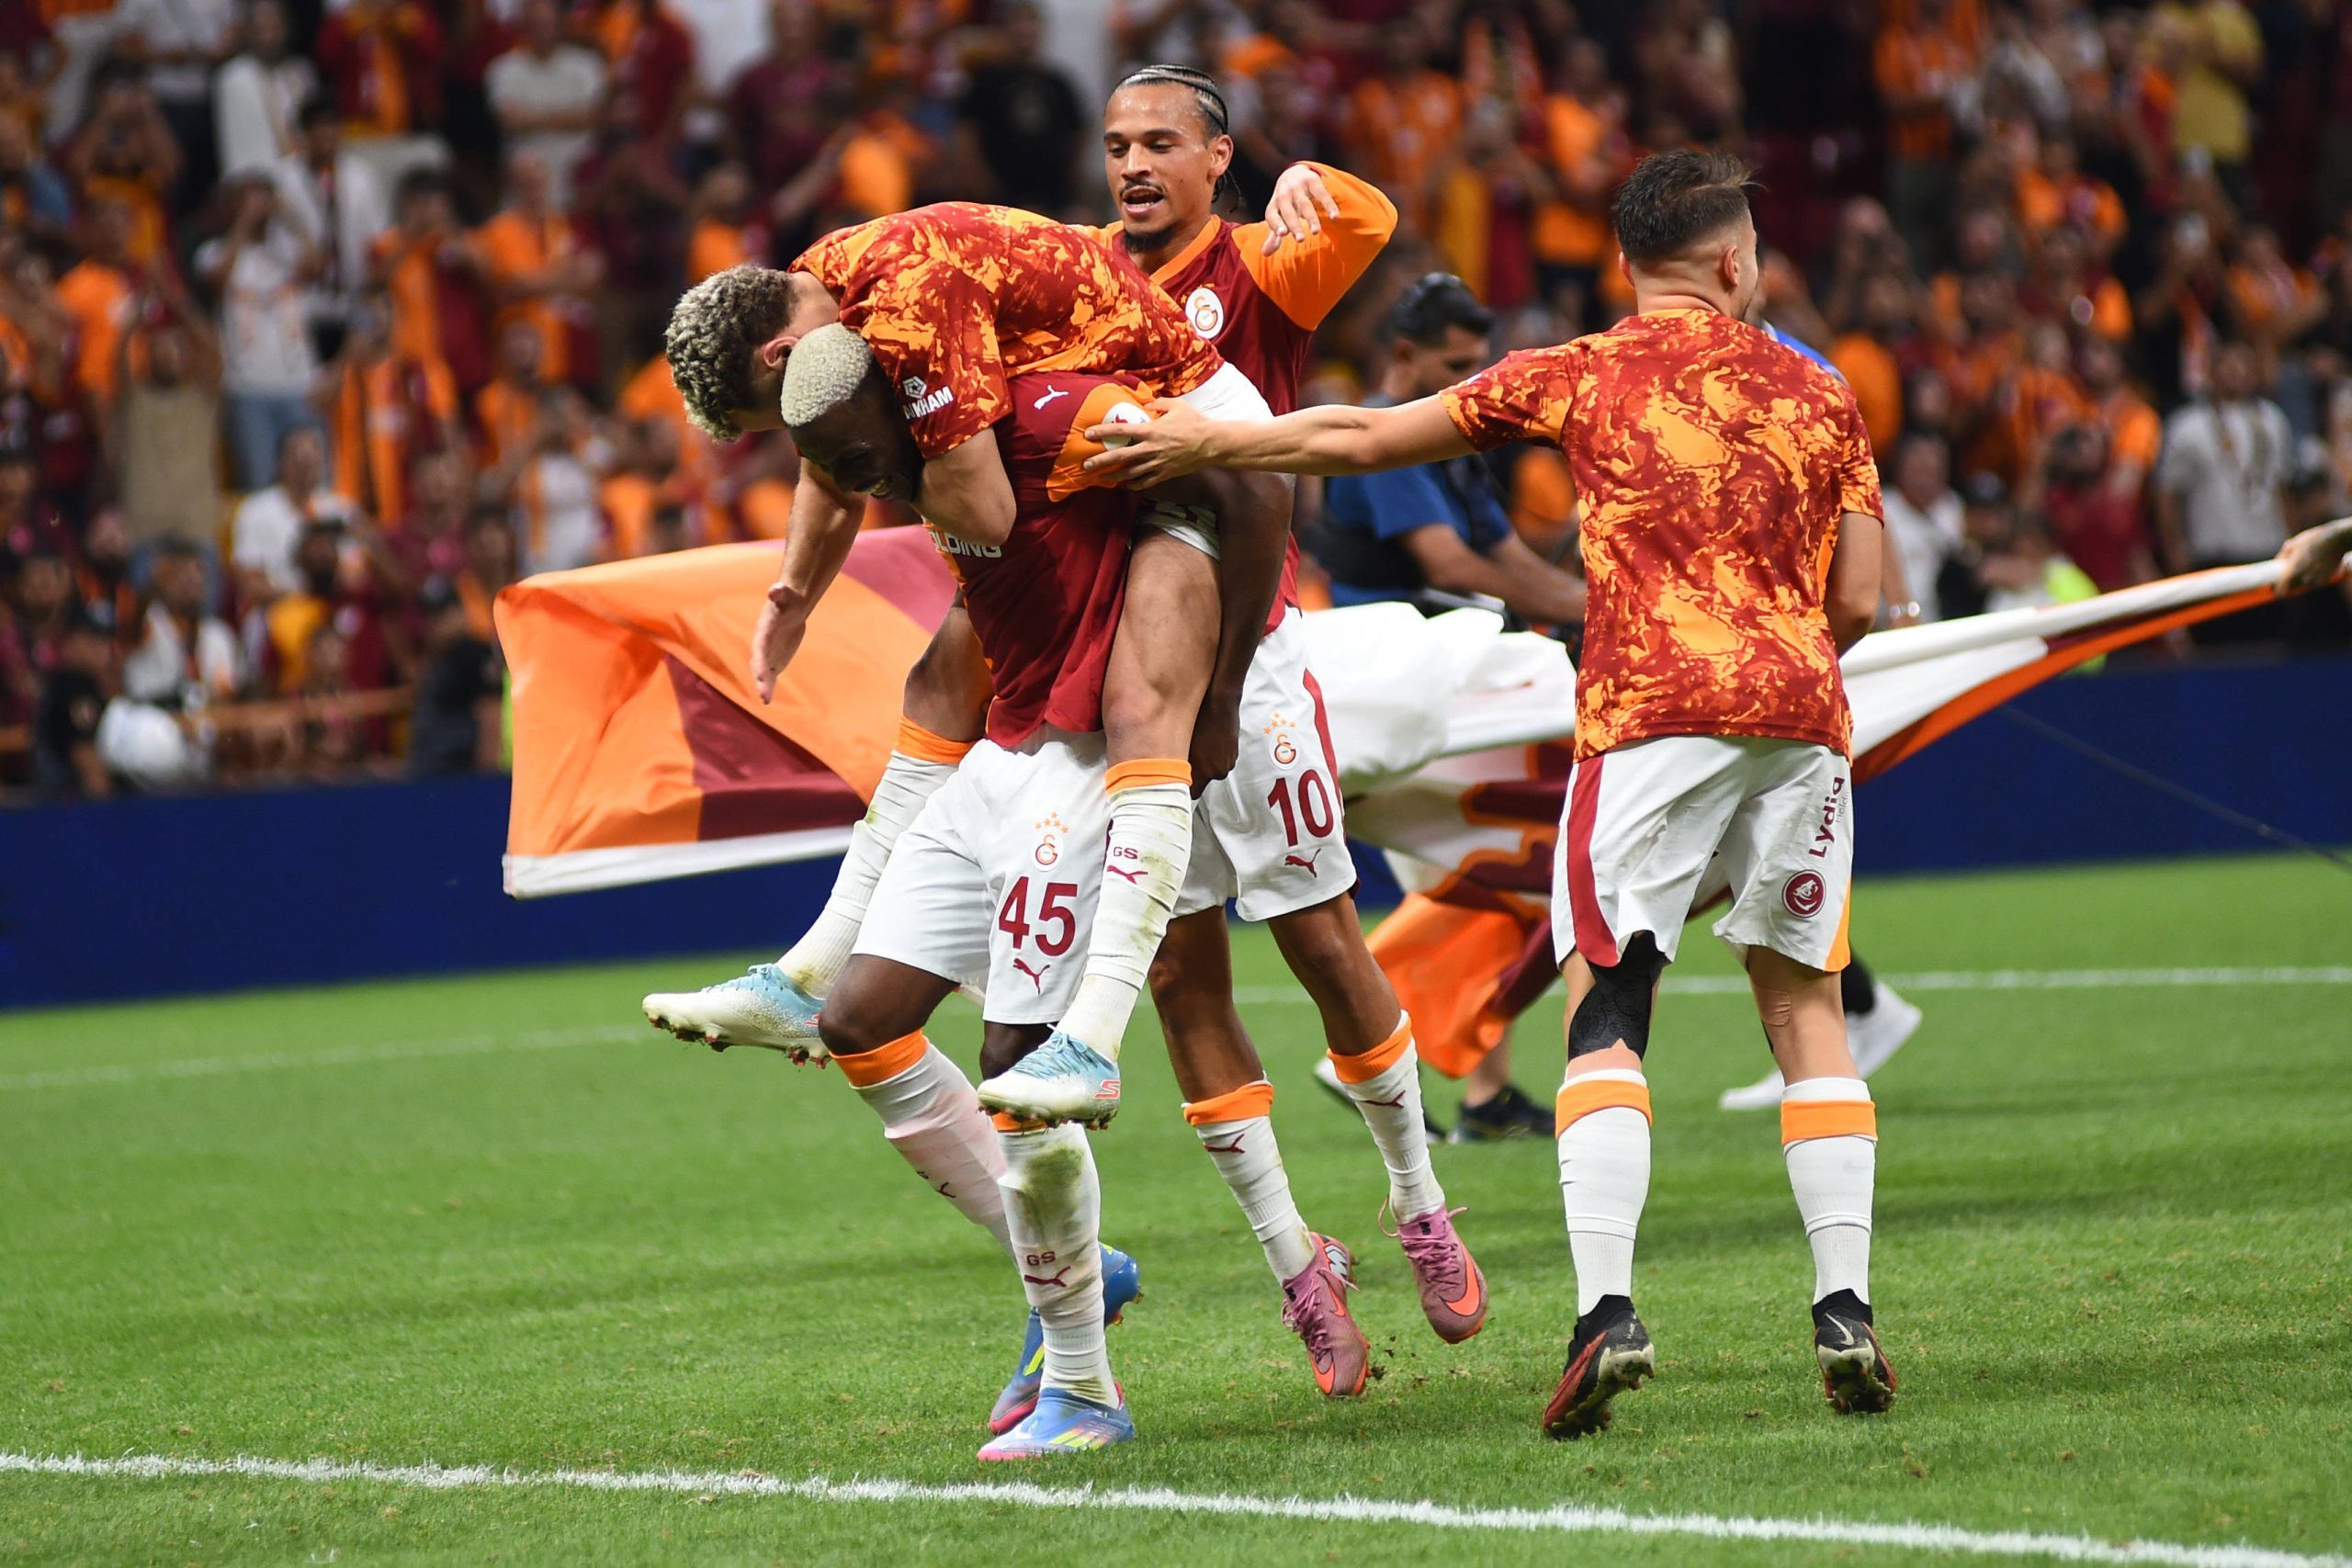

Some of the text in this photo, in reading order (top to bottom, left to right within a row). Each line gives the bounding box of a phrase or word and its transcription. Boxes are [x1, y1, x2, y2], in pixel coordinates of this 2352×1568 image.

[1267, 769, 1335, 847] 10
[1808, 776, 1846, 859] Lydia
[1113, 846, 1139, 861] GS
[998, 875, 1079, 957] 45
[1025, 1250, 1057, 1267] GS
